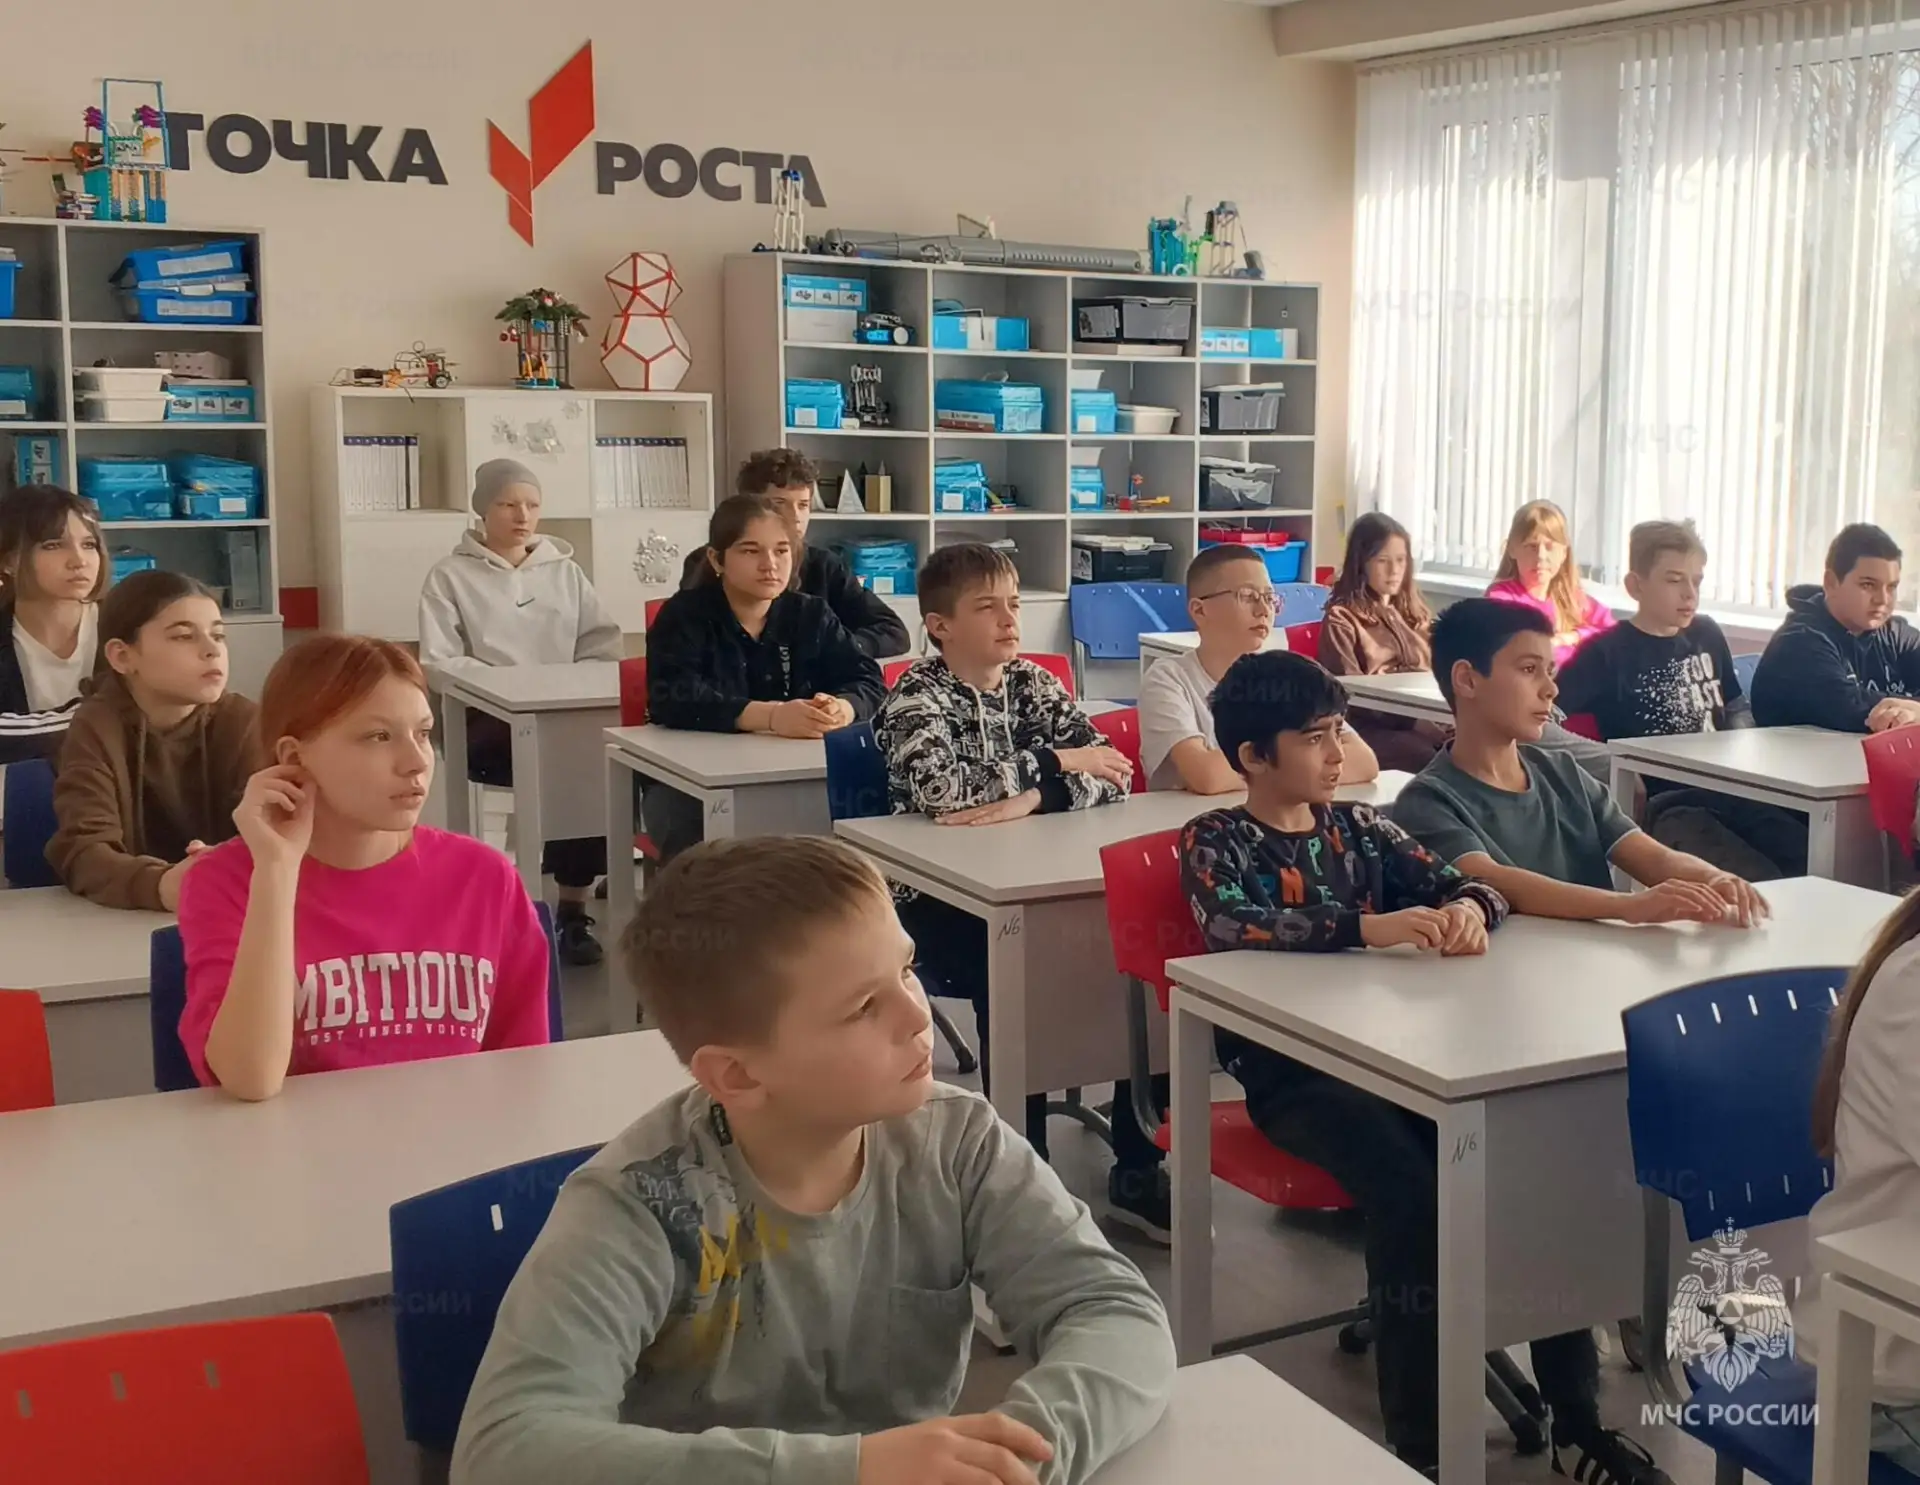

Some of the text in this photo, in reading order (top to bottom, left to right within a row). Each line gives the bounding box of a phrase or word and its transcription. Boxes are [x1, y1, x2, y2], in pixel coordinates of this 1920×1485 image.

[164, 111, 827, 208] ТОЧКА РОСТА
[294, 950, 494, 1043] MBITIOUS
